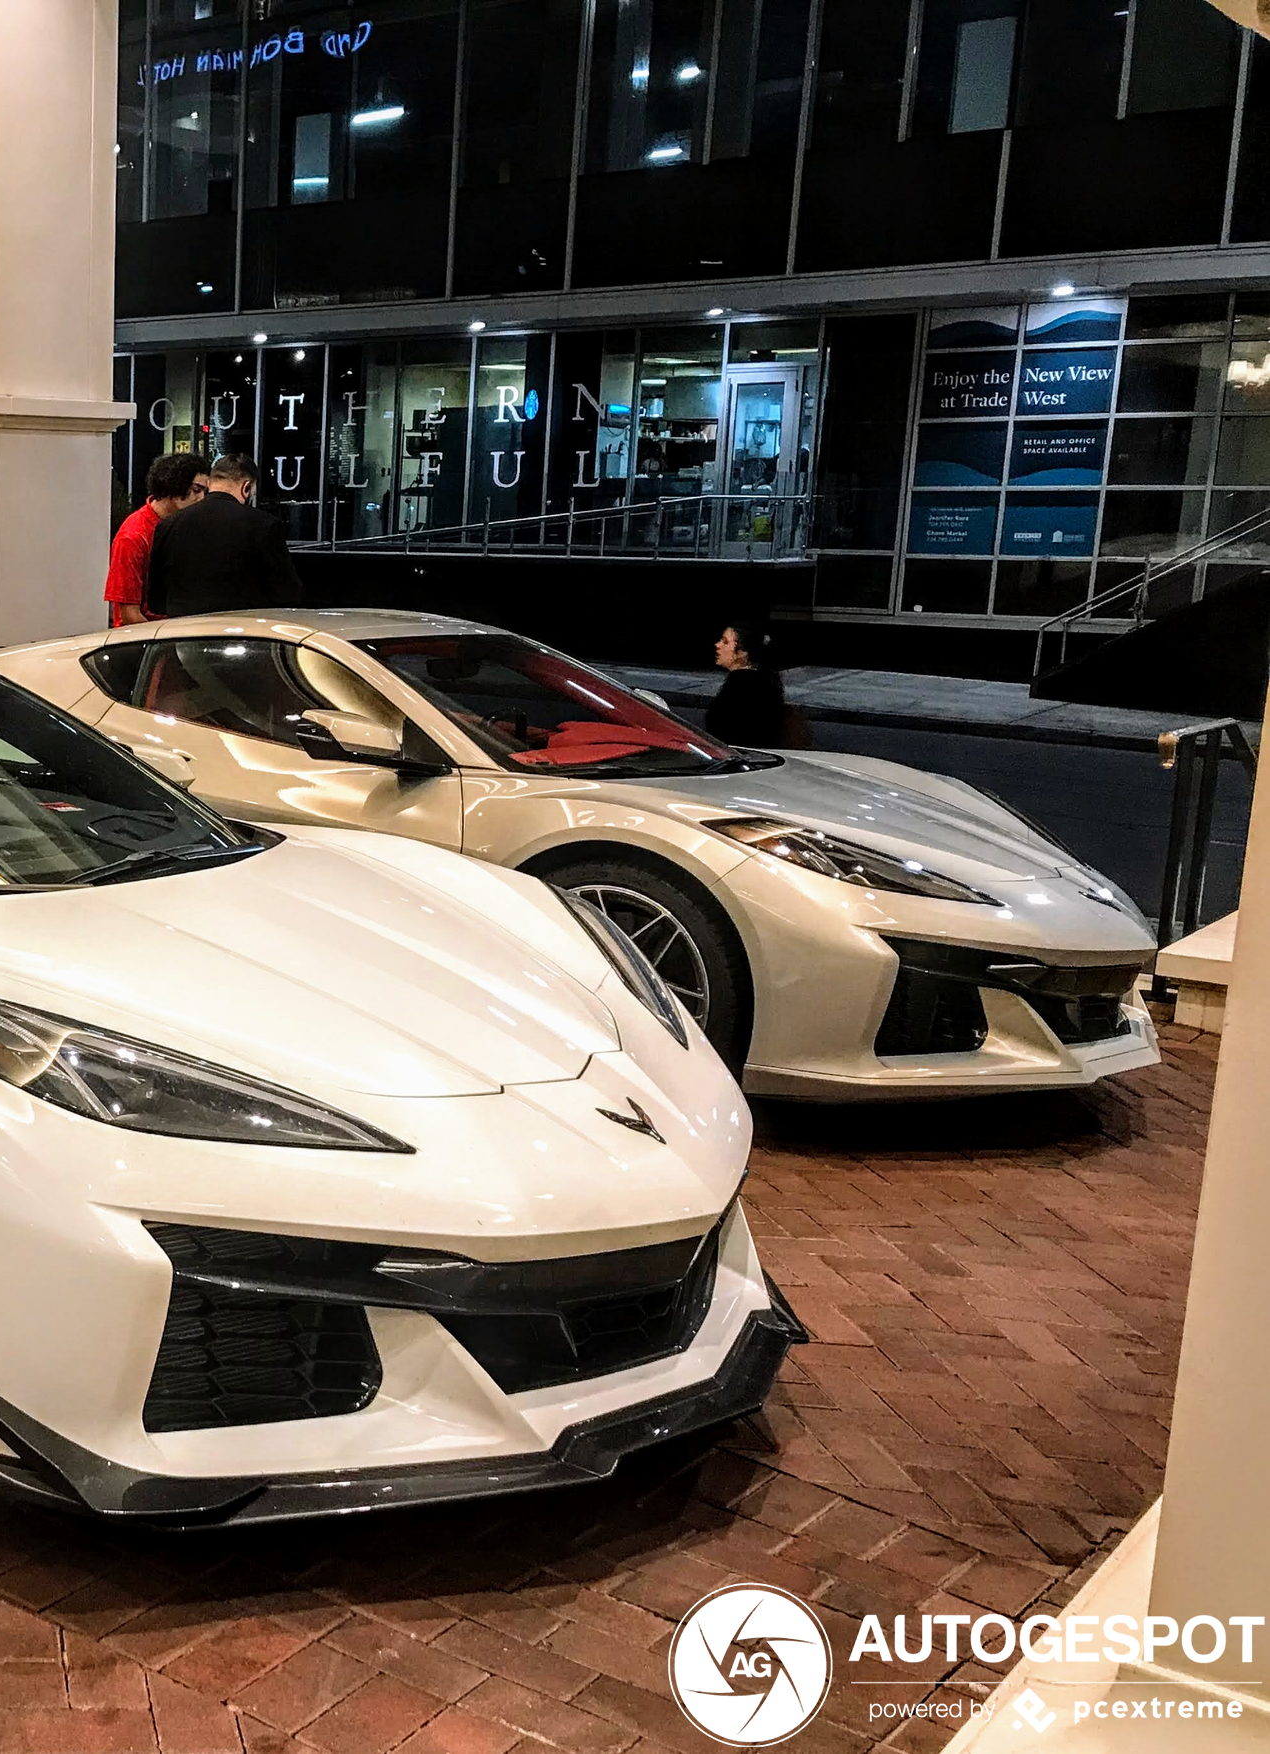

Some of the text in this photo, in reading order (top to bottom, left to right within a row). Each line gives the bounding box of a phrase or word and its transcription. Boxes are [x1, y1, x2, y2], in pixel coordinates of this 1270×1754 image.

[933, 365, 1113, 390] Enjoy the New View
[149, 383, 606, 431] OUTHERN
[940, 391, 1067, 408] at Trade West
[1048, 446, 1087, 454] AVAILABLE
[274, 450, 602, 491] ULFUL
